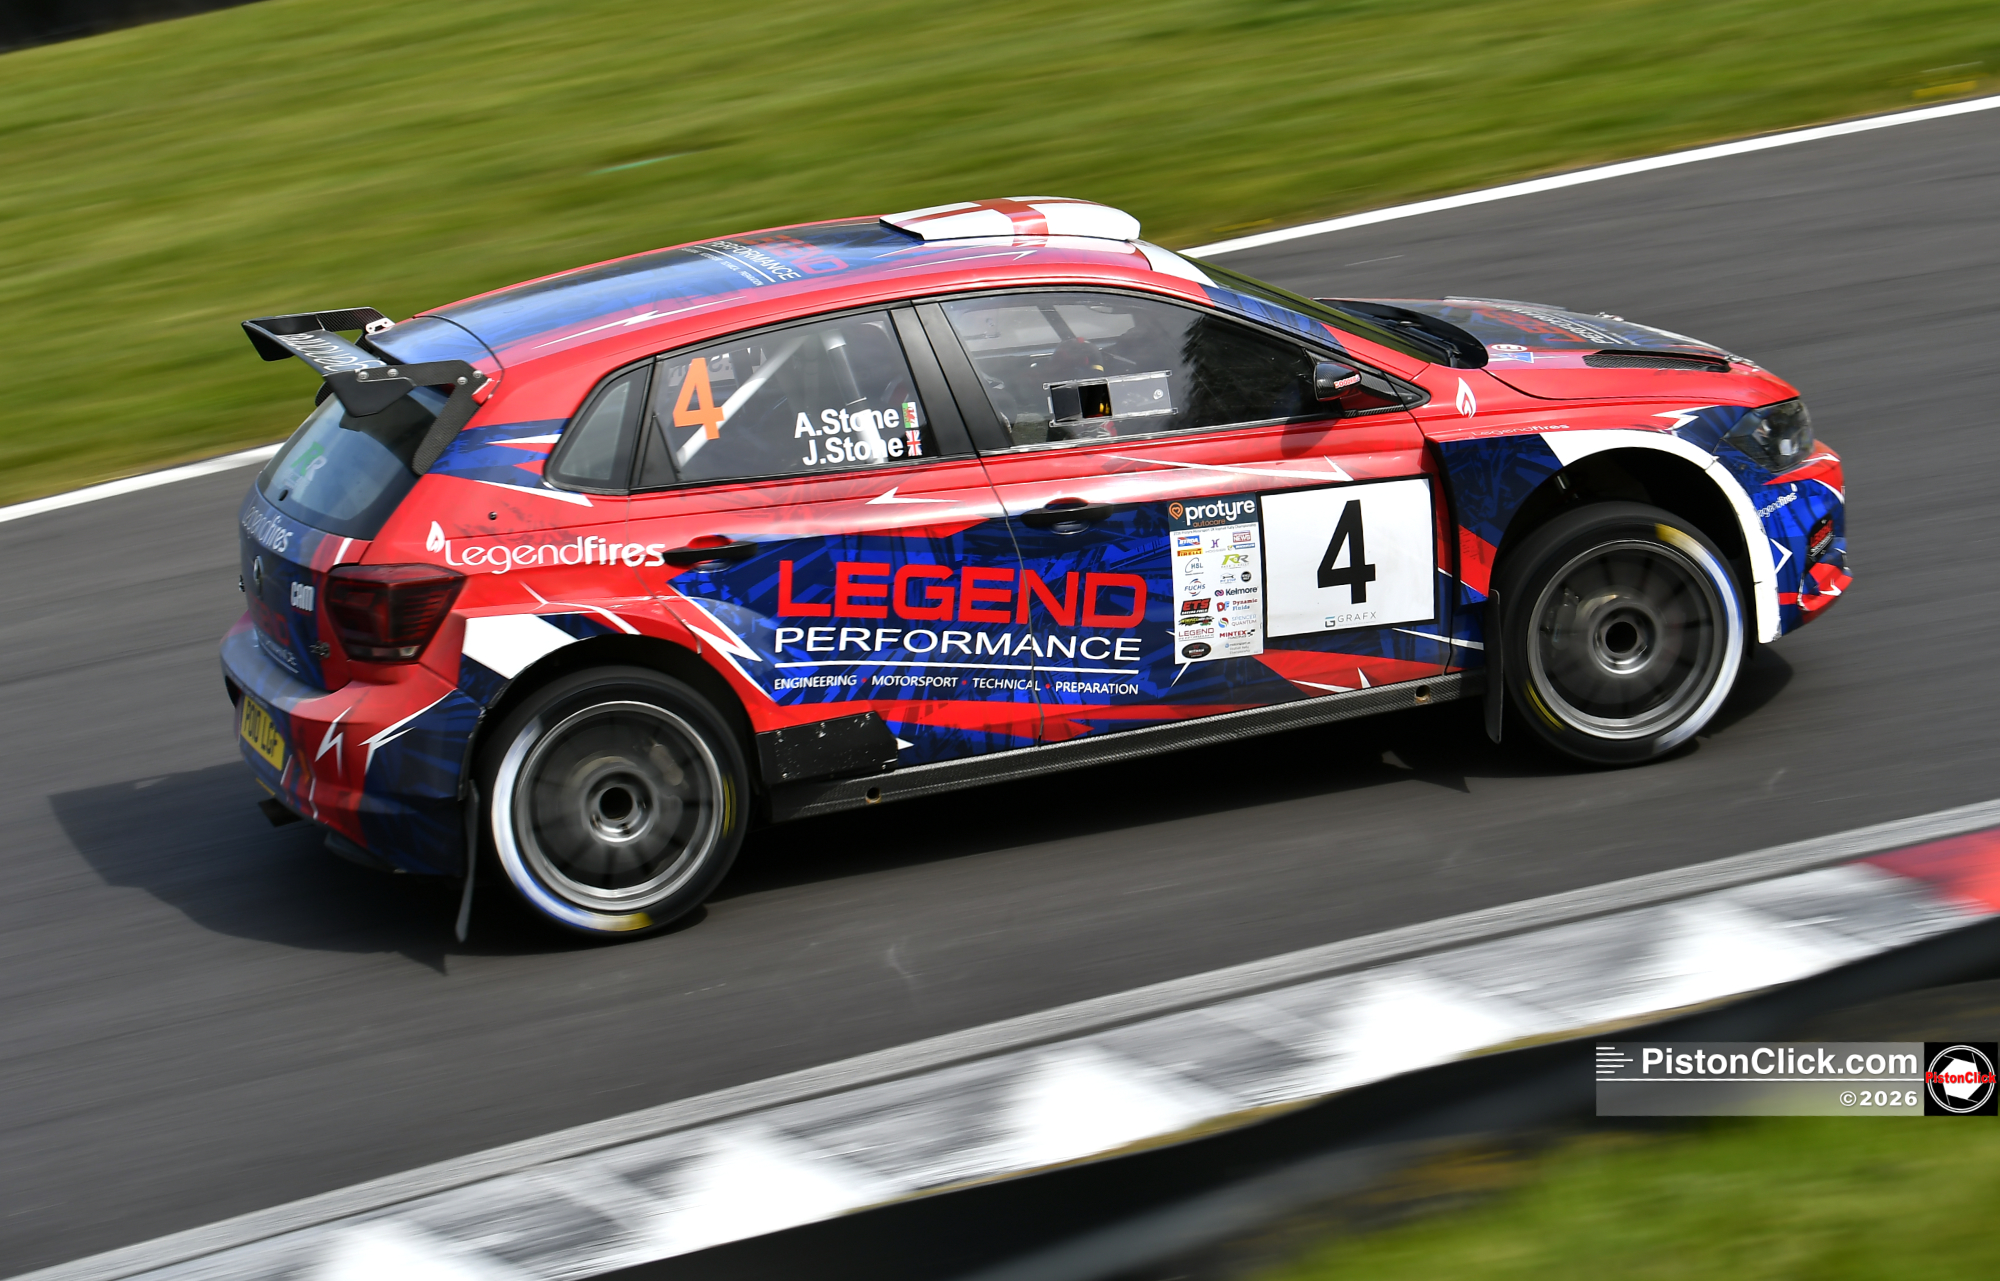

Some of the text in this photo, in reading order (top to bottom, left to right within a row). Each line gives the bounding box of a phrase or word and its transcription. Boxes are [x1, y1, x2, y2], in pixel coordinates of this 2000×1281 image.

[673, 357, 725, 440] 4
[794, 408, 900, 439] A.Stone
[802, 437, 904, 466] J.Stone
[1185, 500, 1255, 526] protyre
[1193, 519, 1226, 528] autocare
[445, 536, 666, 575] Legendfires
[1317, 499, 1376, 605] 4
[777, 560, 1147, 629] LEGEND
[1184, 583, 1206, 592] FUCHS
[1226, 587, 1257, 596] Kelmore
[1182, 599, 1210, 611] ETS
[1232, 598, 1258, 606] Dynamic
[1231, 619, 1257, 627] QUANTUM
[1337, 611, 1377, 623] GRAFX
[1178, 627, 1215, 637] LEGEND
[1220, 629, 1247, 638] MINTEX
[775, 627, 1142, 661] PERFORMANCE
[774, 675, 1139, 695] ENGINEERING MOTORSPORT TECHNICAL PREPARATION
